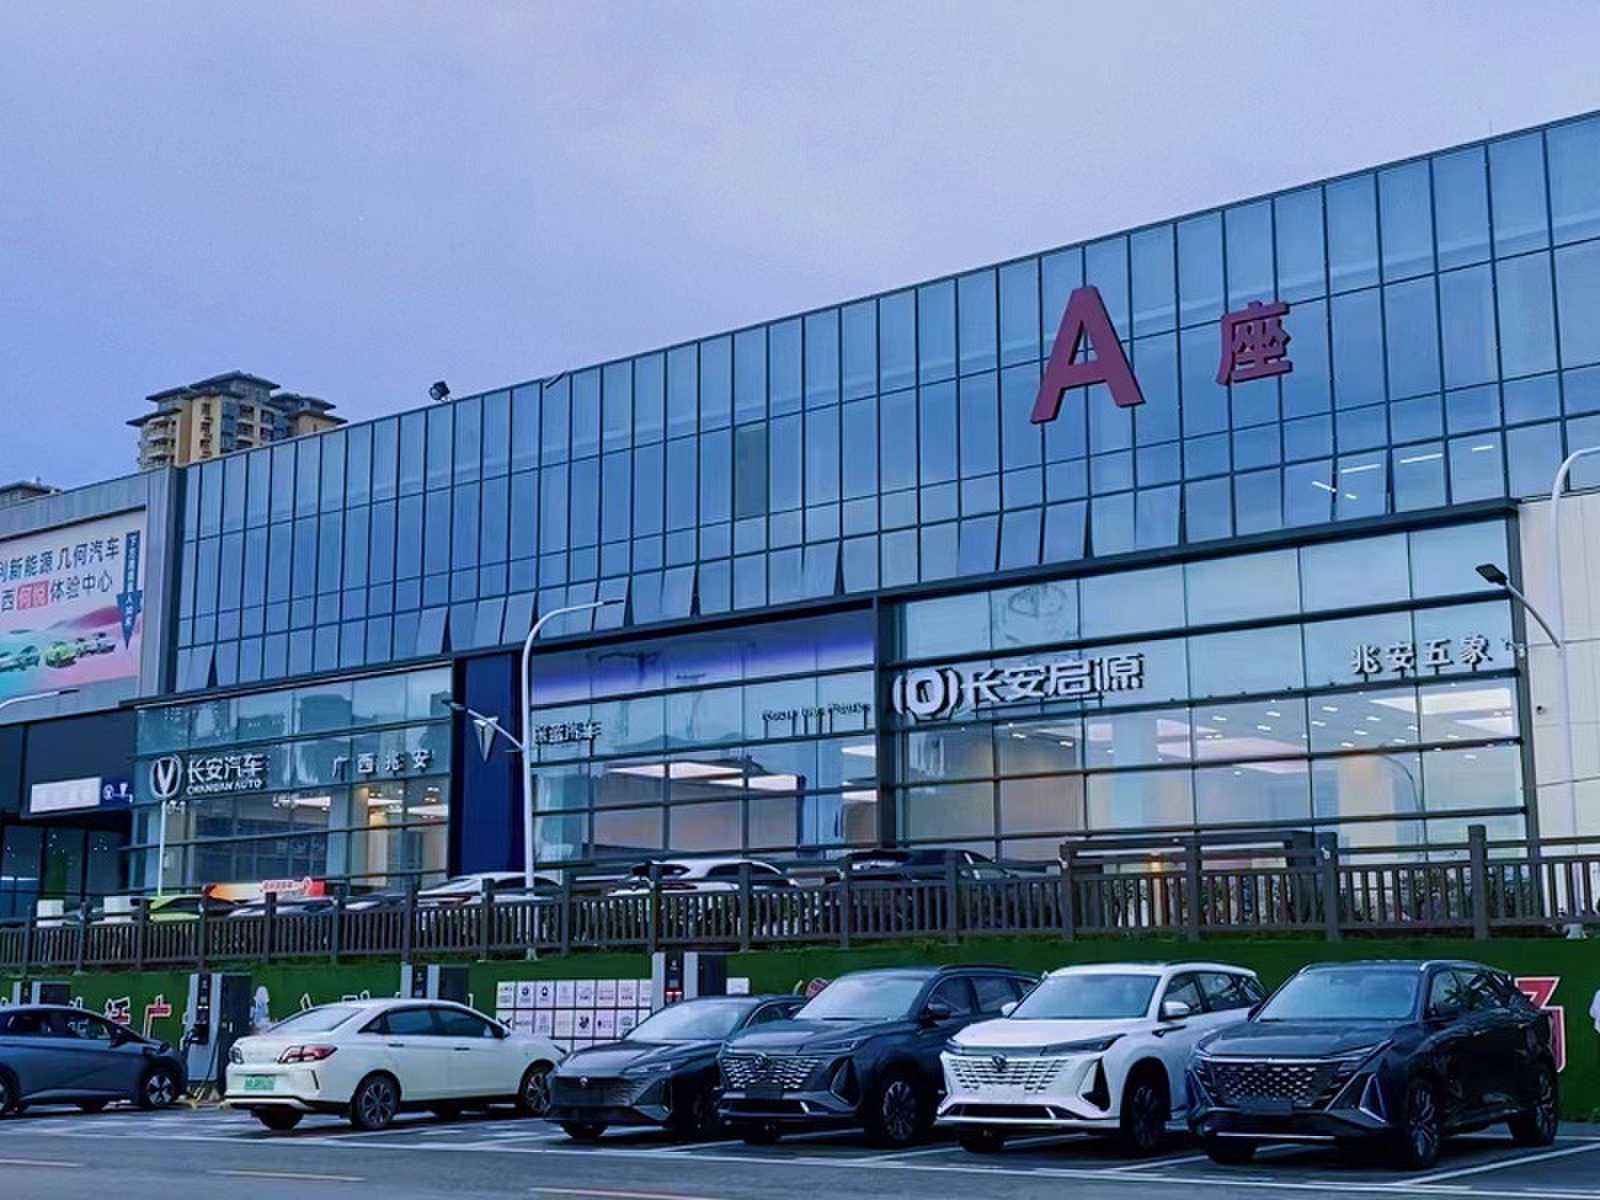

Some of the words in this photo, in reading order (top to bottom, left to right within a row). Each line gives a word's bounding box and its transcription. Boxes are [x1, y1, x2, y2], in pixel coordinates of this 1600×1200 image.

[1031, 285, 1146, 424] A
[1216, 300, 1293, 384] 座
[57, 536, 120, 570] 几何汽车
[1352, 636, 1491, 674] 兆安五家
[961, 653, 1145, 704] 长安启源
[188, 753, 264, 783] 长安汽车
